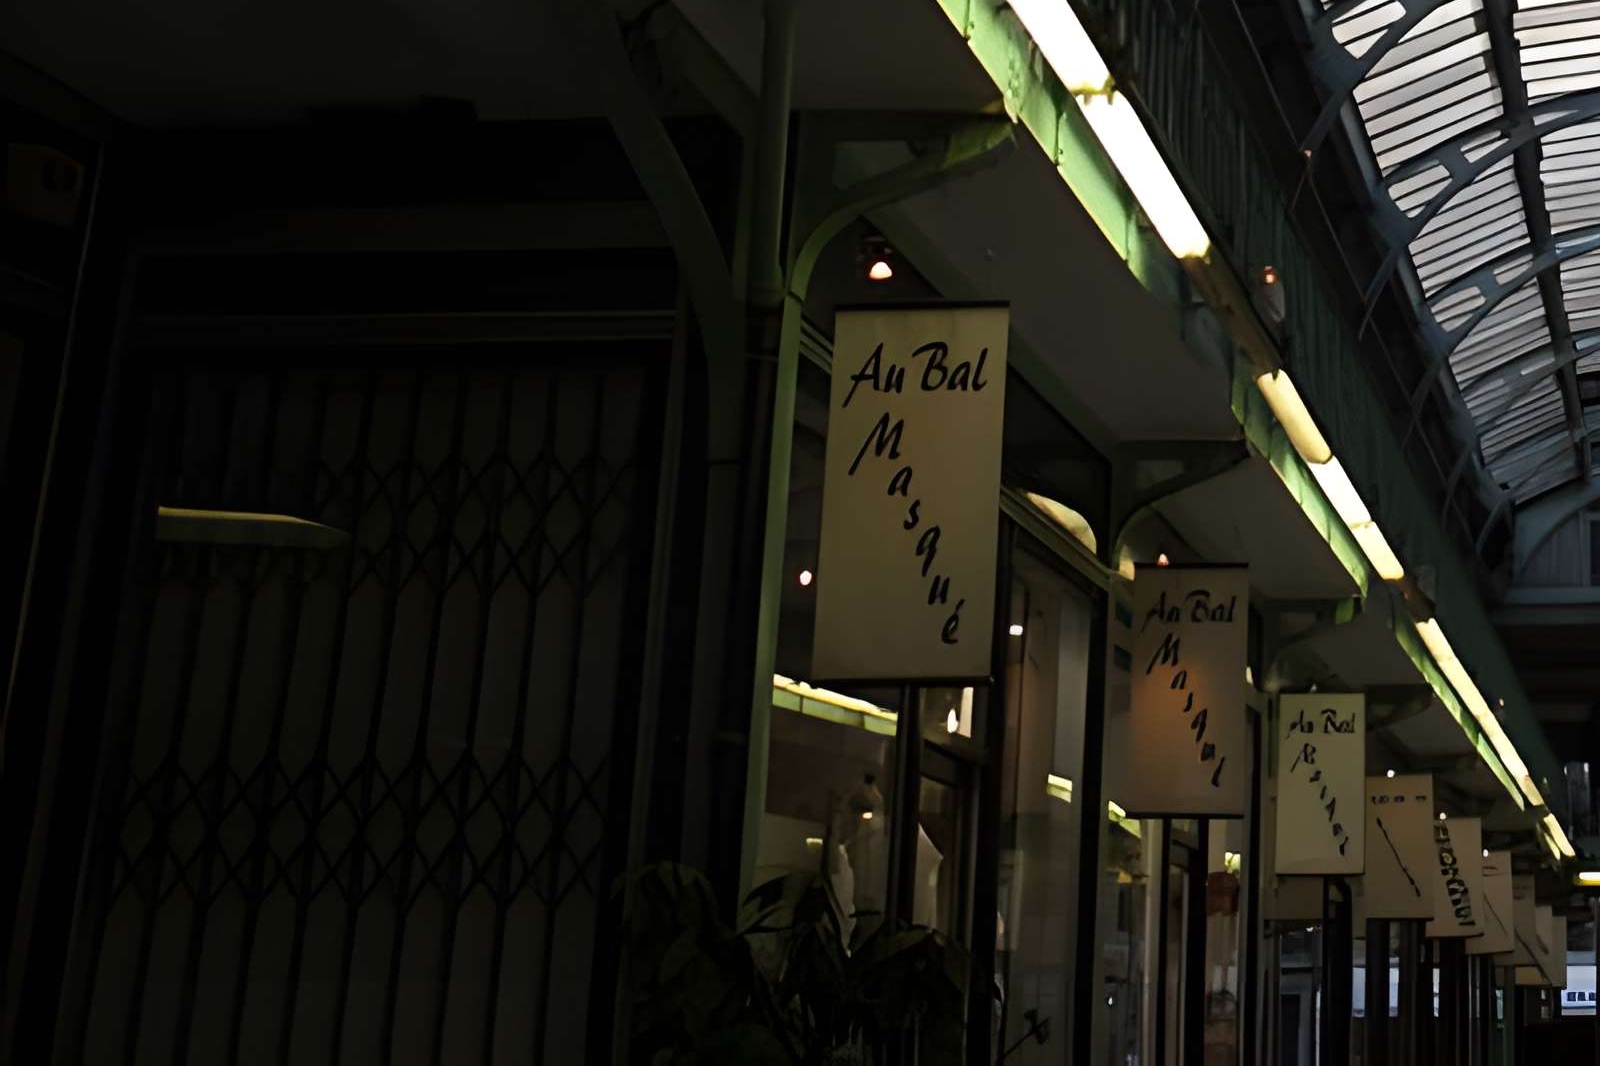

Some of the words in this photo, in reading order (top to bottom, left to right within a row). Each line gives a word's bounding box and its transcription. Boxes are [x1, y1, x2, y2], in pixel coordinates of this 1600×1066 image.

[843, 342, 905, 408] Au
[912, 341, 988, 392] Bal
[848, 412, 965, 644] Masqué
[1185, 589, 1237, 622] Bal
